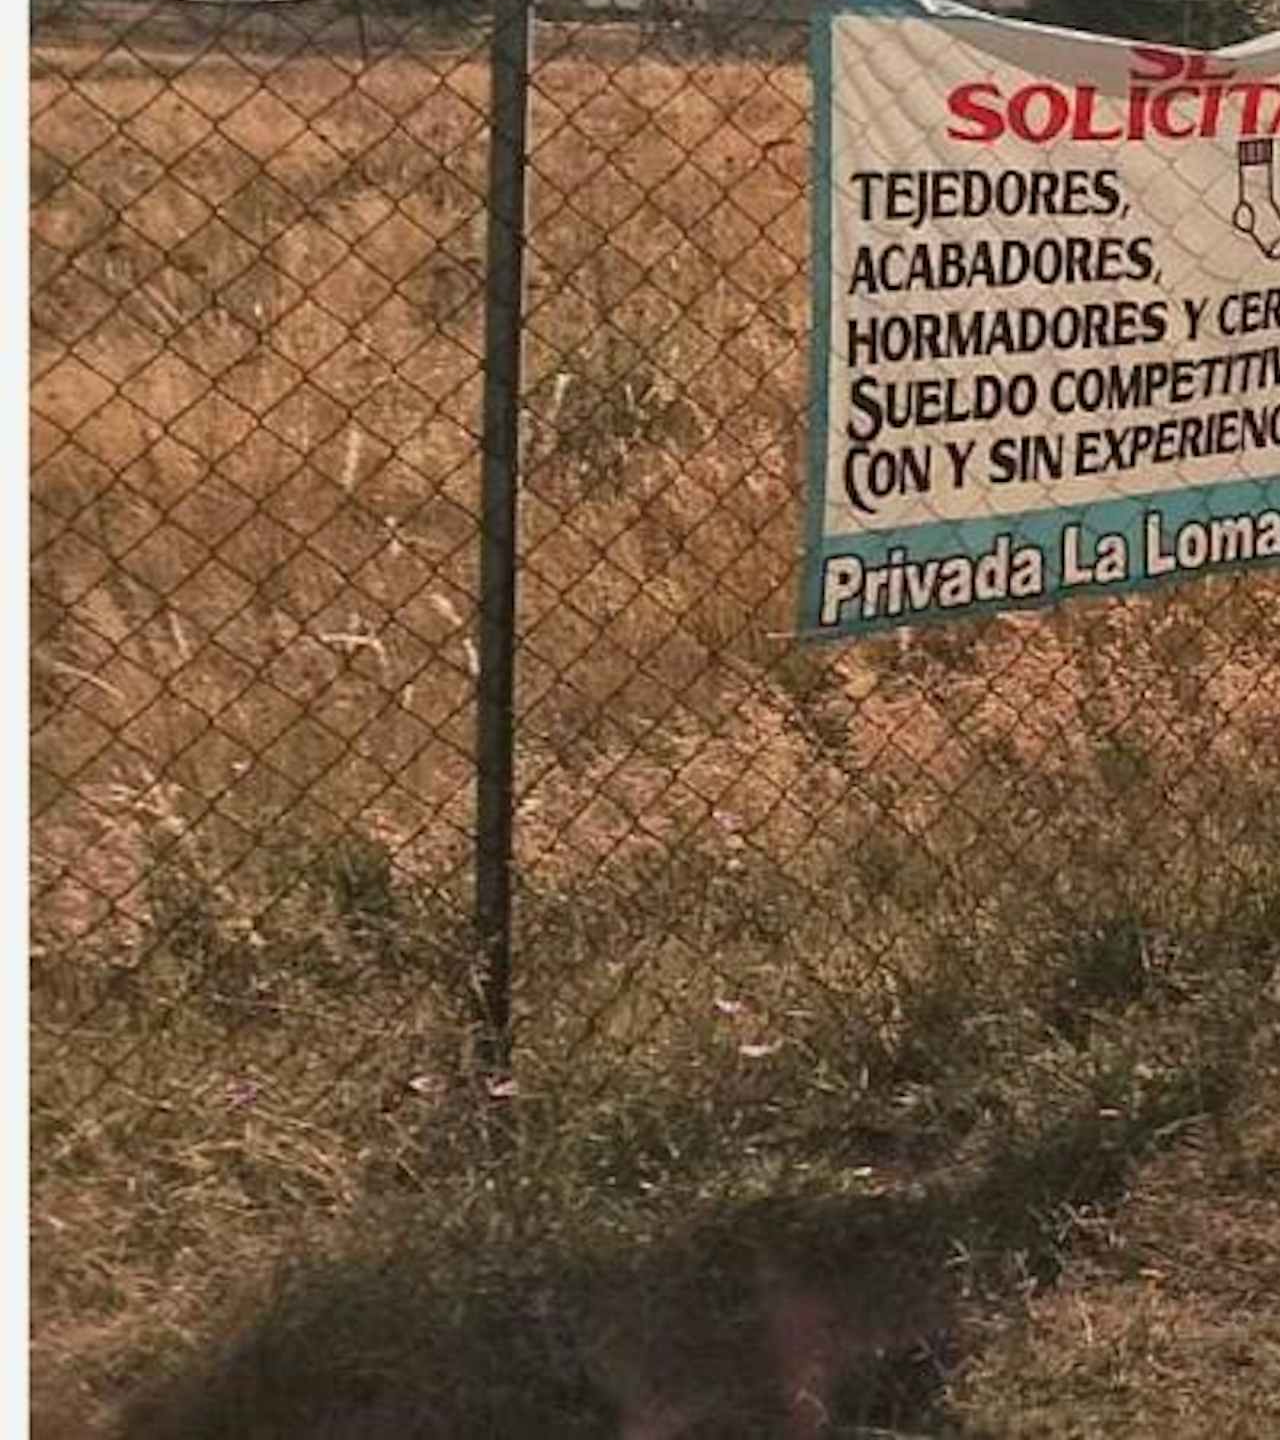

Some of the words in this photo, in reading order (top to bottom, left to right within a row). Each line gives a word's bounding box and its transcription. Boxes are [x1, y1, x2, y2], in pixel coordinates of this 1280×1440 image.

[850, 169, 1131, 229] TEJEDORES,
[847, 237, 1163, 295] ACABADORES,
[846, 301, 1169, 368] HORMADORES
[1183, 299, 1206, 341] Y
[944, 440, 977, 490] Y
[988, 432, 1064, 484] SIN
[819, 532, 1045, 626] Privada
[1060, 524, 1127, 586] La
